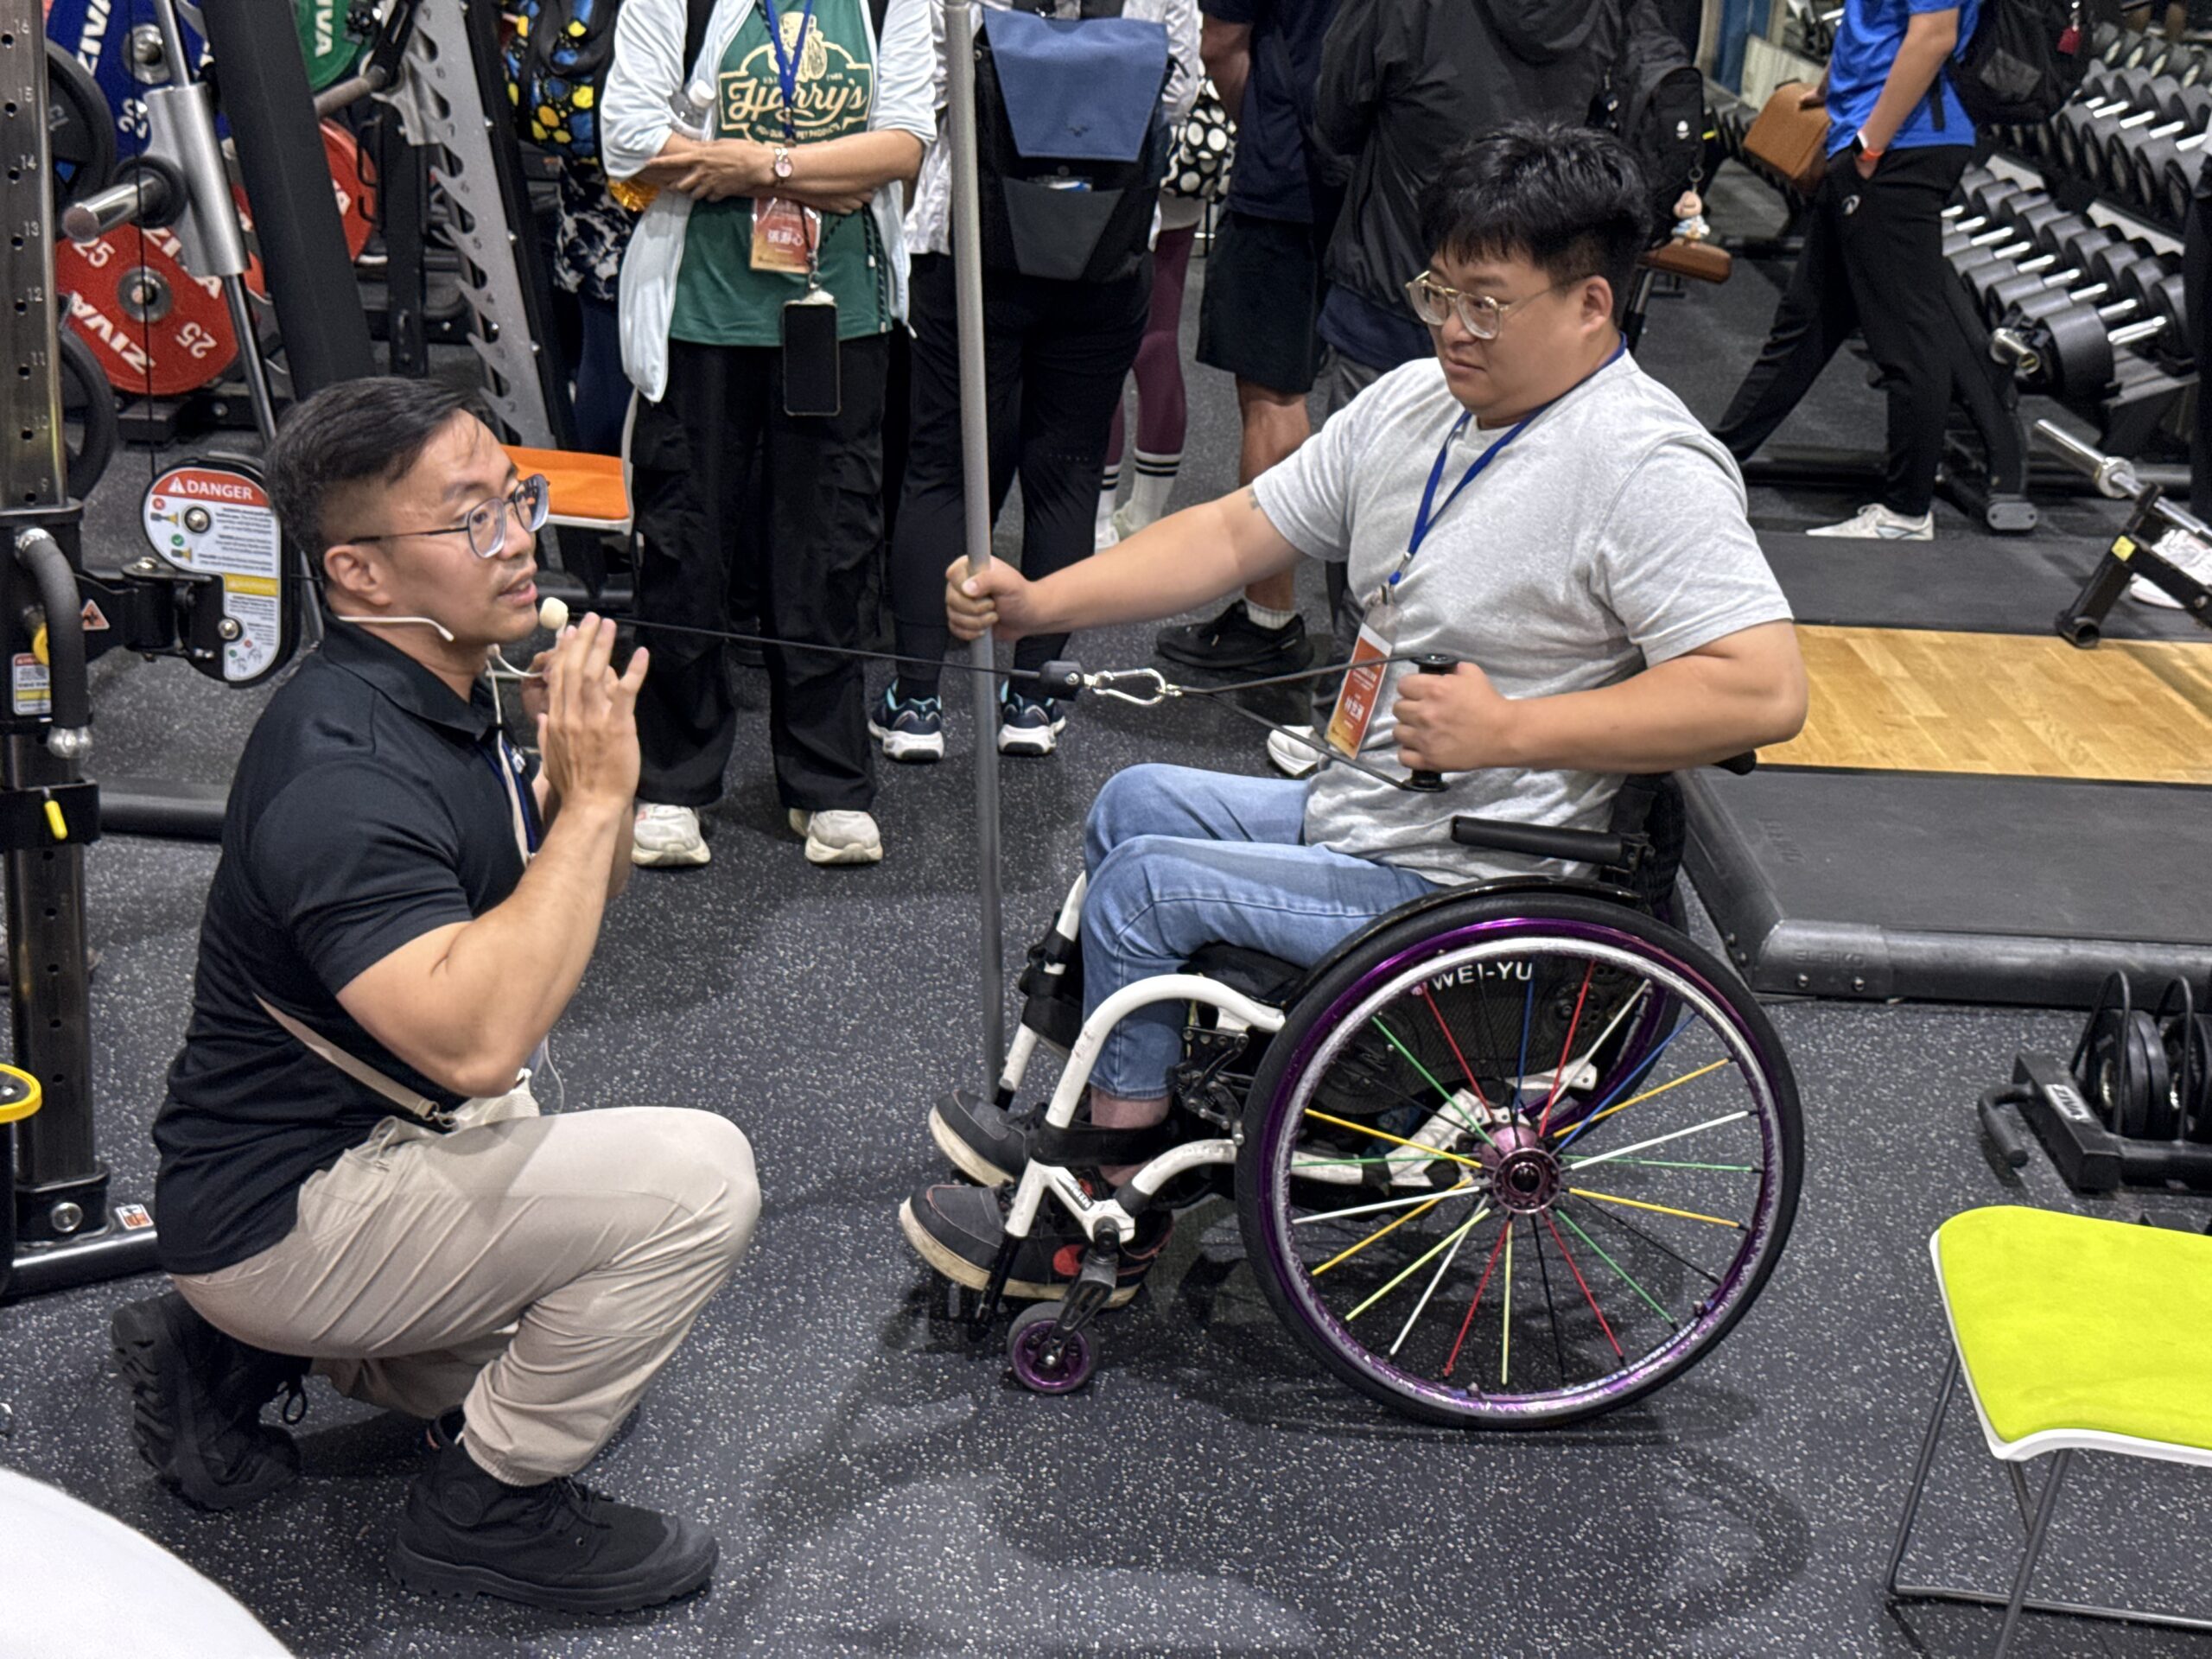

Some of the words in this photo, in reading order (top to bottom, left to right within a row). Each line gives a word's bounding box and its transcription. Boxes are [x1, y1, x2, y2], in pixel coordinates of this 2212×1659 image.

[20, 155, 37, 170] 14
[23, 220, 41, 238] 13
[142, 226, 223, 300] ZIA
[27, 286, 44, 302] 12
[71, 290, 157, 376] ZIVA
[175, 321, 218, 359] 25
[187, 480, 254, 500] DANGER
[1432, 961, 1533, 991] WEI-YU
